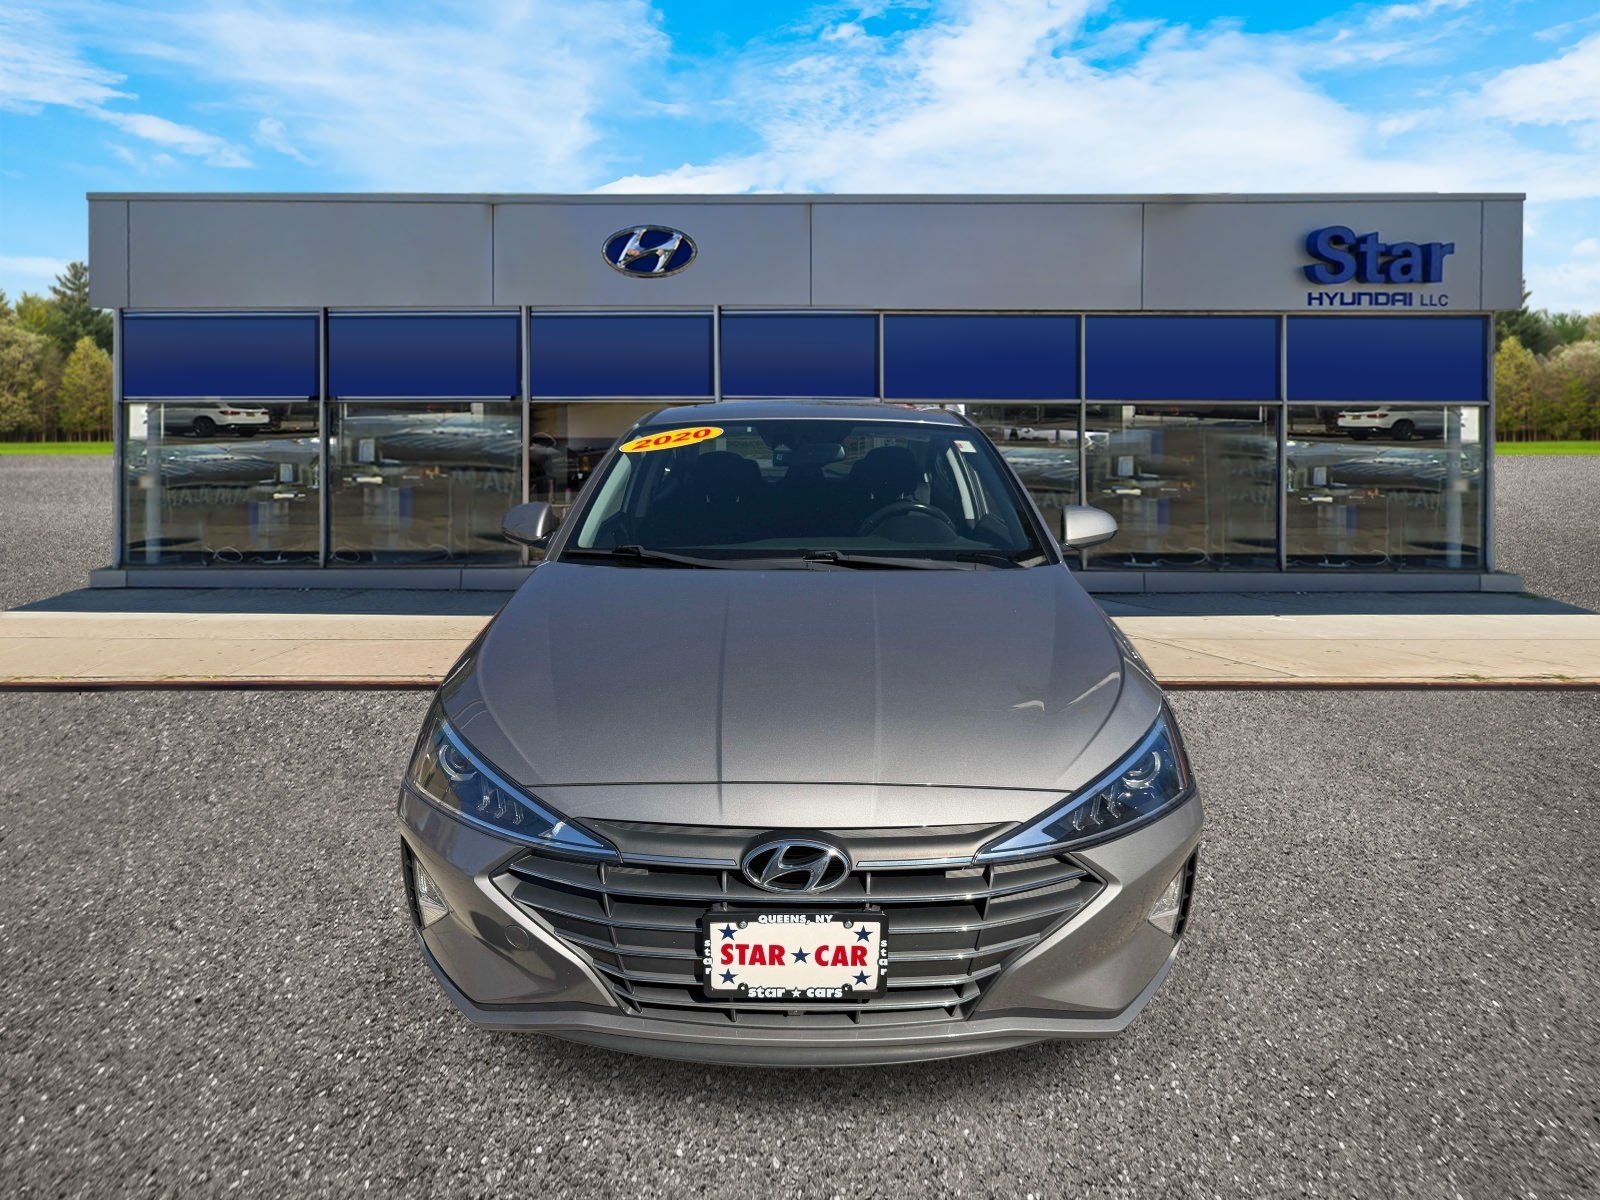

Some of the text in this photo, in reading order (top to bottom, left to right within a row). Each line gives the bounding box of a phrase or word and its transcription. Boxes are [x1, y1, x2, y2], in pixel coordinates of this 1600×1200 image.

[1303, 225, 1455, 284] Star
[1307, 292, 1449, 306] HYUNDAI LLC
[632, 429, 712, 451] 2020
[758, 914, 834, 925] QUEENS, NY
[703, 939, 713, 975] star
[720, 943, 868, 967] STAR CAR
[878, 939, 888, 976] star
[748, 985, 843, 998] star cars
